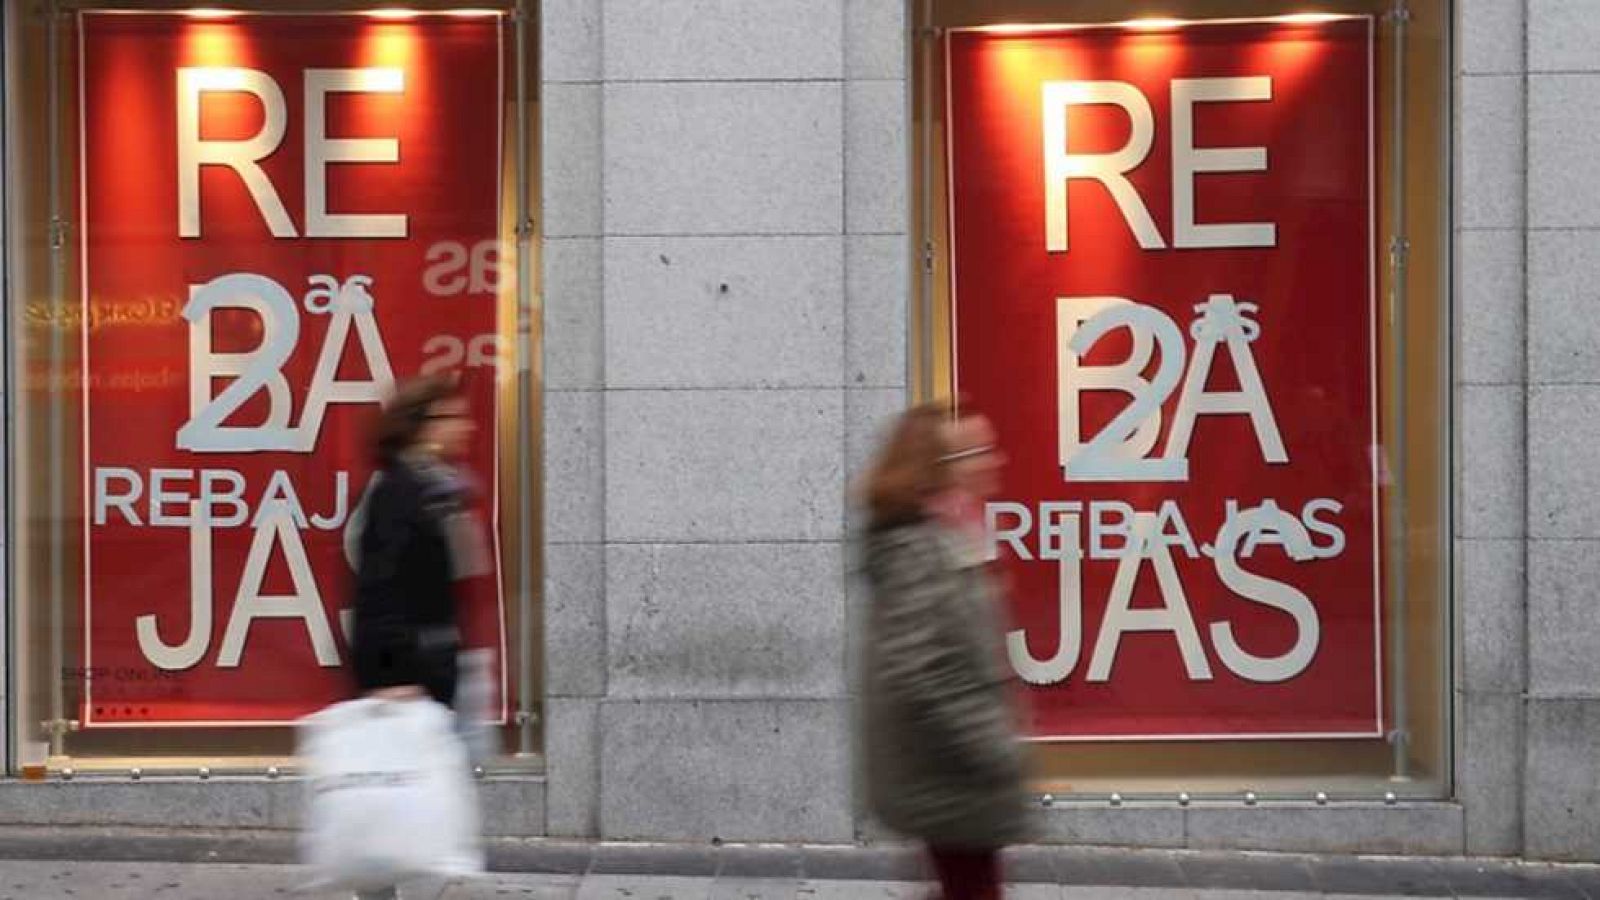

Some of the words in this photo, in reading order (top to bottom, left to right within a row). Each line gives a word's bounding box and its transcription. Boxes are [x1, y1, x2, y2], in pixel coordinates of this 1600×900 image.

[176, 68, 408, 239] RE
[1041, 76, 1276, 251] RE
[189, 284, 397, 452] BA
[1055, 295, 1289, 466] BA
[94, 467, 382, 530] REBAJ
[984, 498, 1346, 561] REBAJAS
[1006, 508, 1320, 684] JAS
